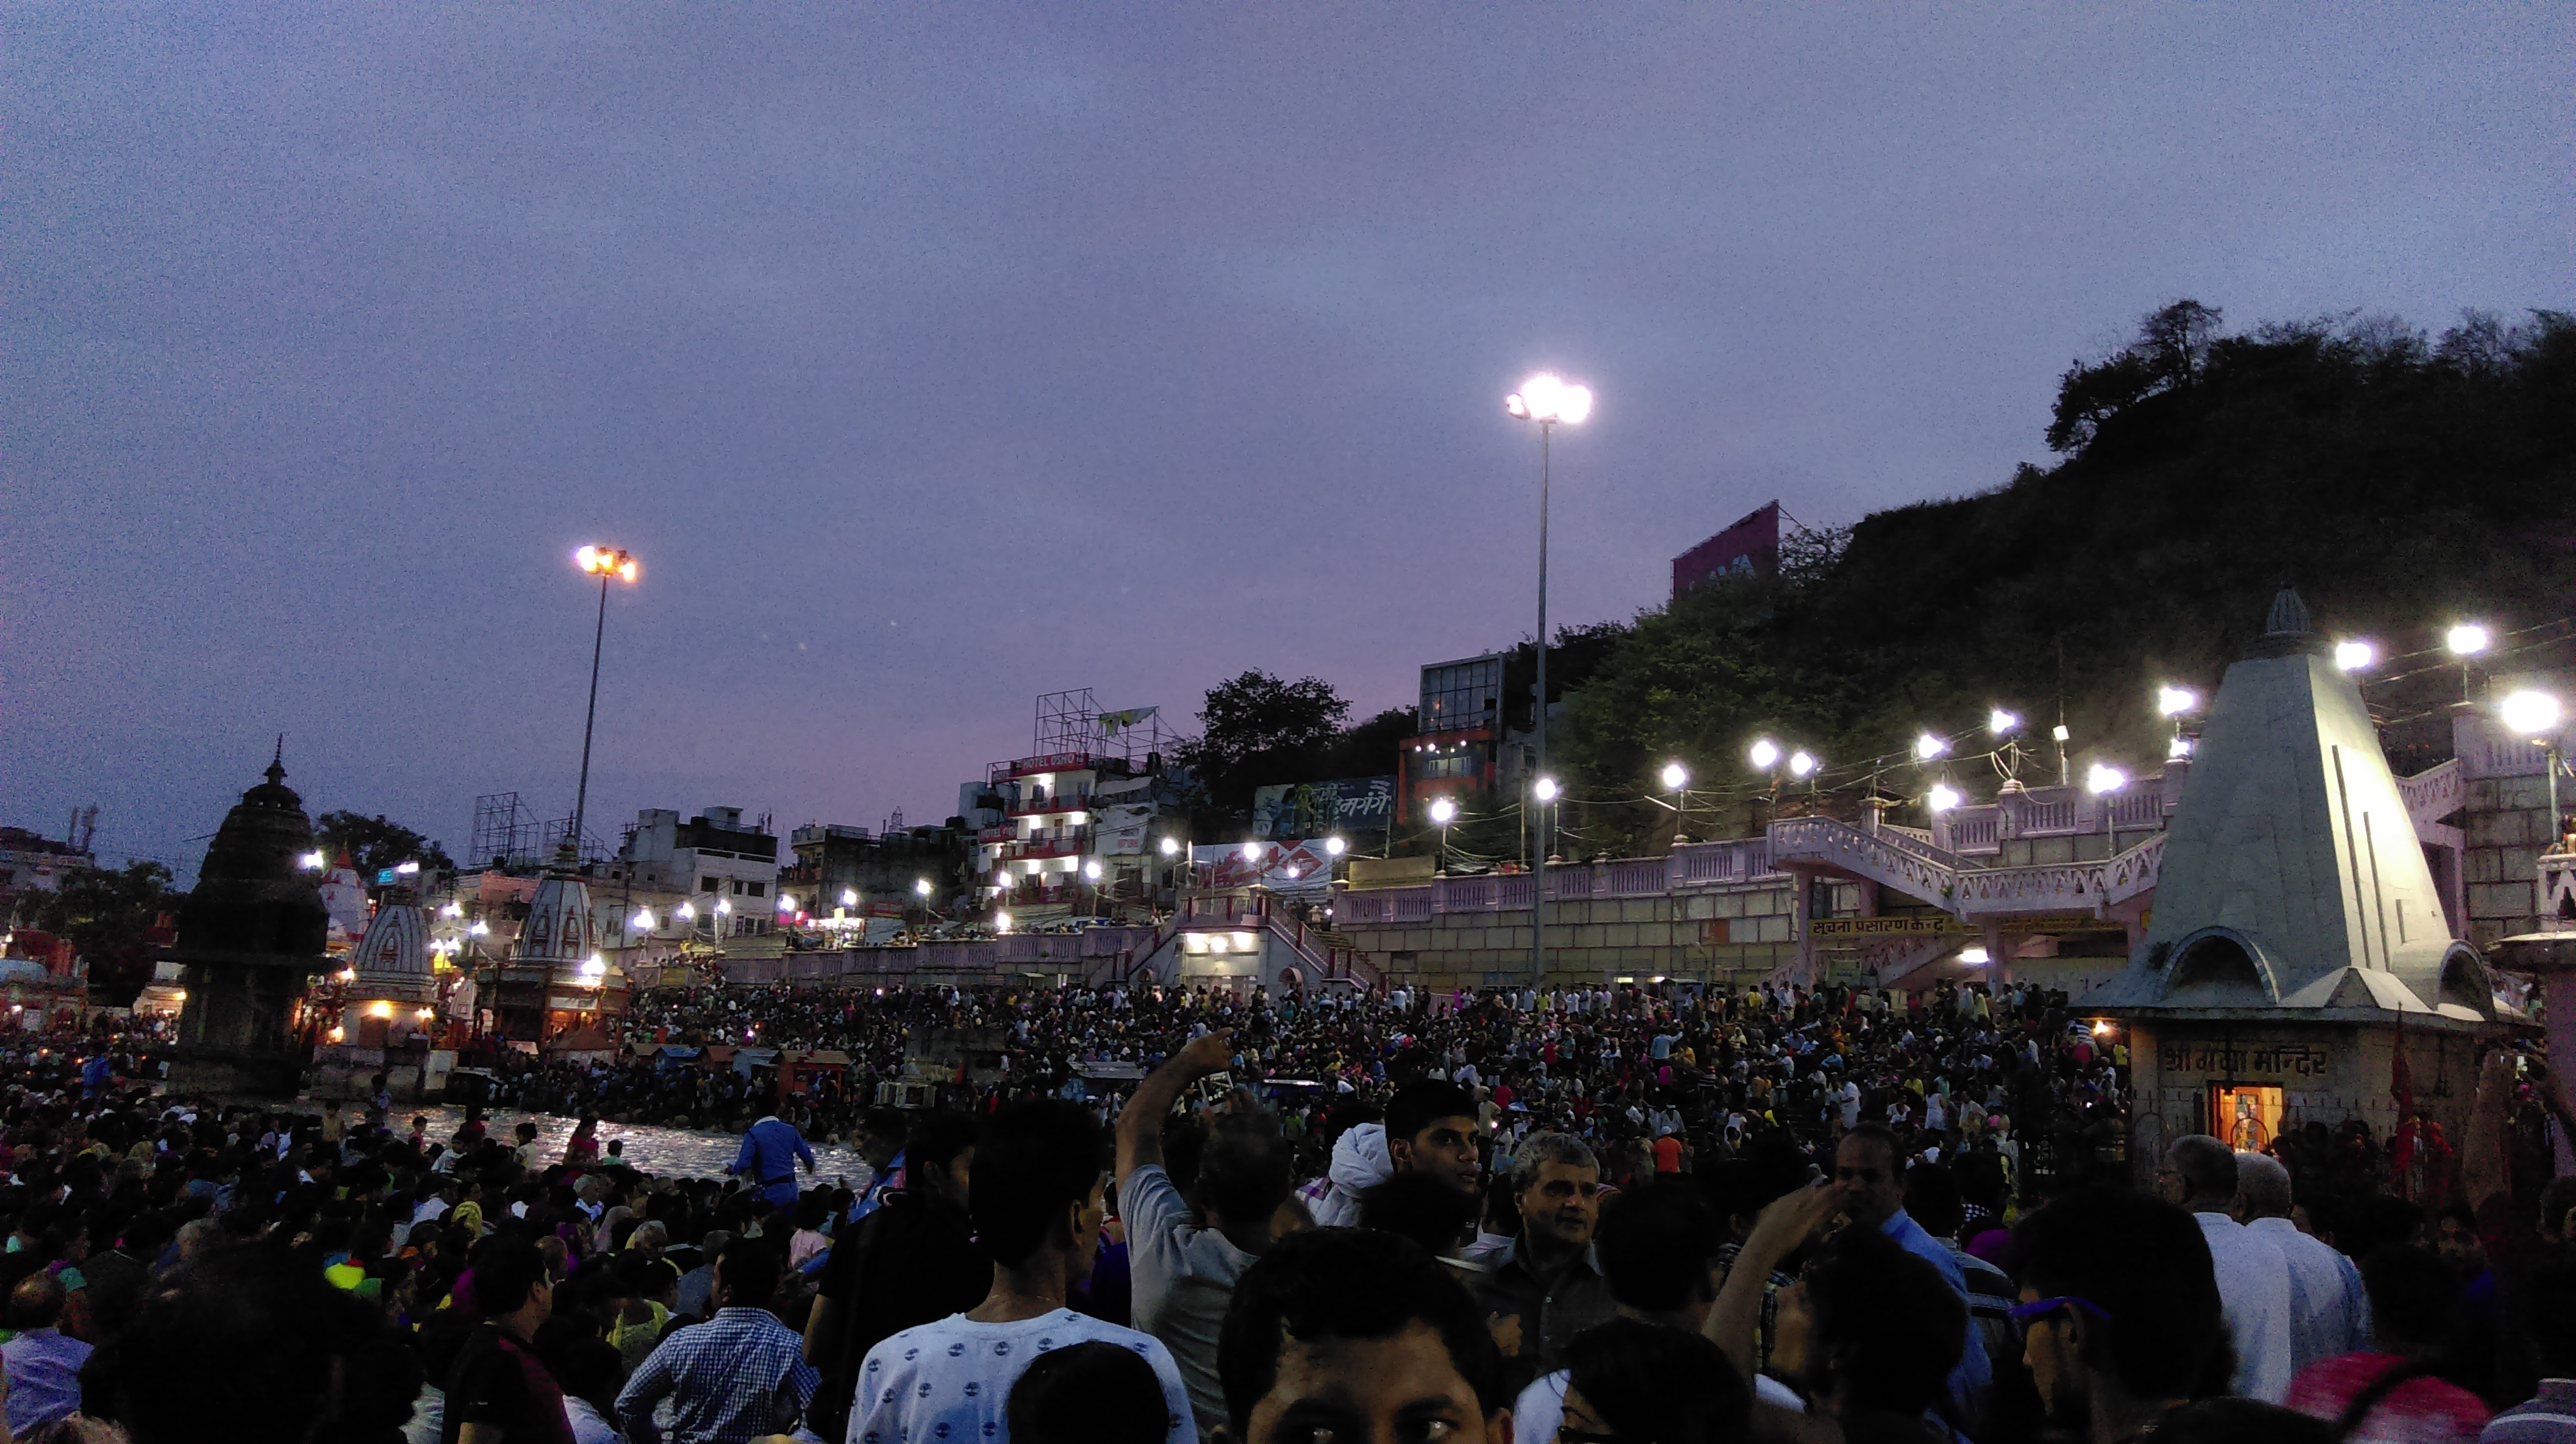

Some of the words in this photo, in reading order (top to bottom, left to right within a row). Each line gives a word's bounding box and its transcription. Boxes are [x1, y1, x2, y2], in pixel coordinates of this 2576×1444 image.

[1023, 757, 1048, 770] HOTEL
[1051, 754, 1075, 765] OSHO
[1813, 921, 1852, 935] सूचना
[1855, 920, 1909, 933] प्रसारण
[2164, 1043, 2191, 1071] श्री
[2253, 1045, 2327, 1076] मन्दिर
